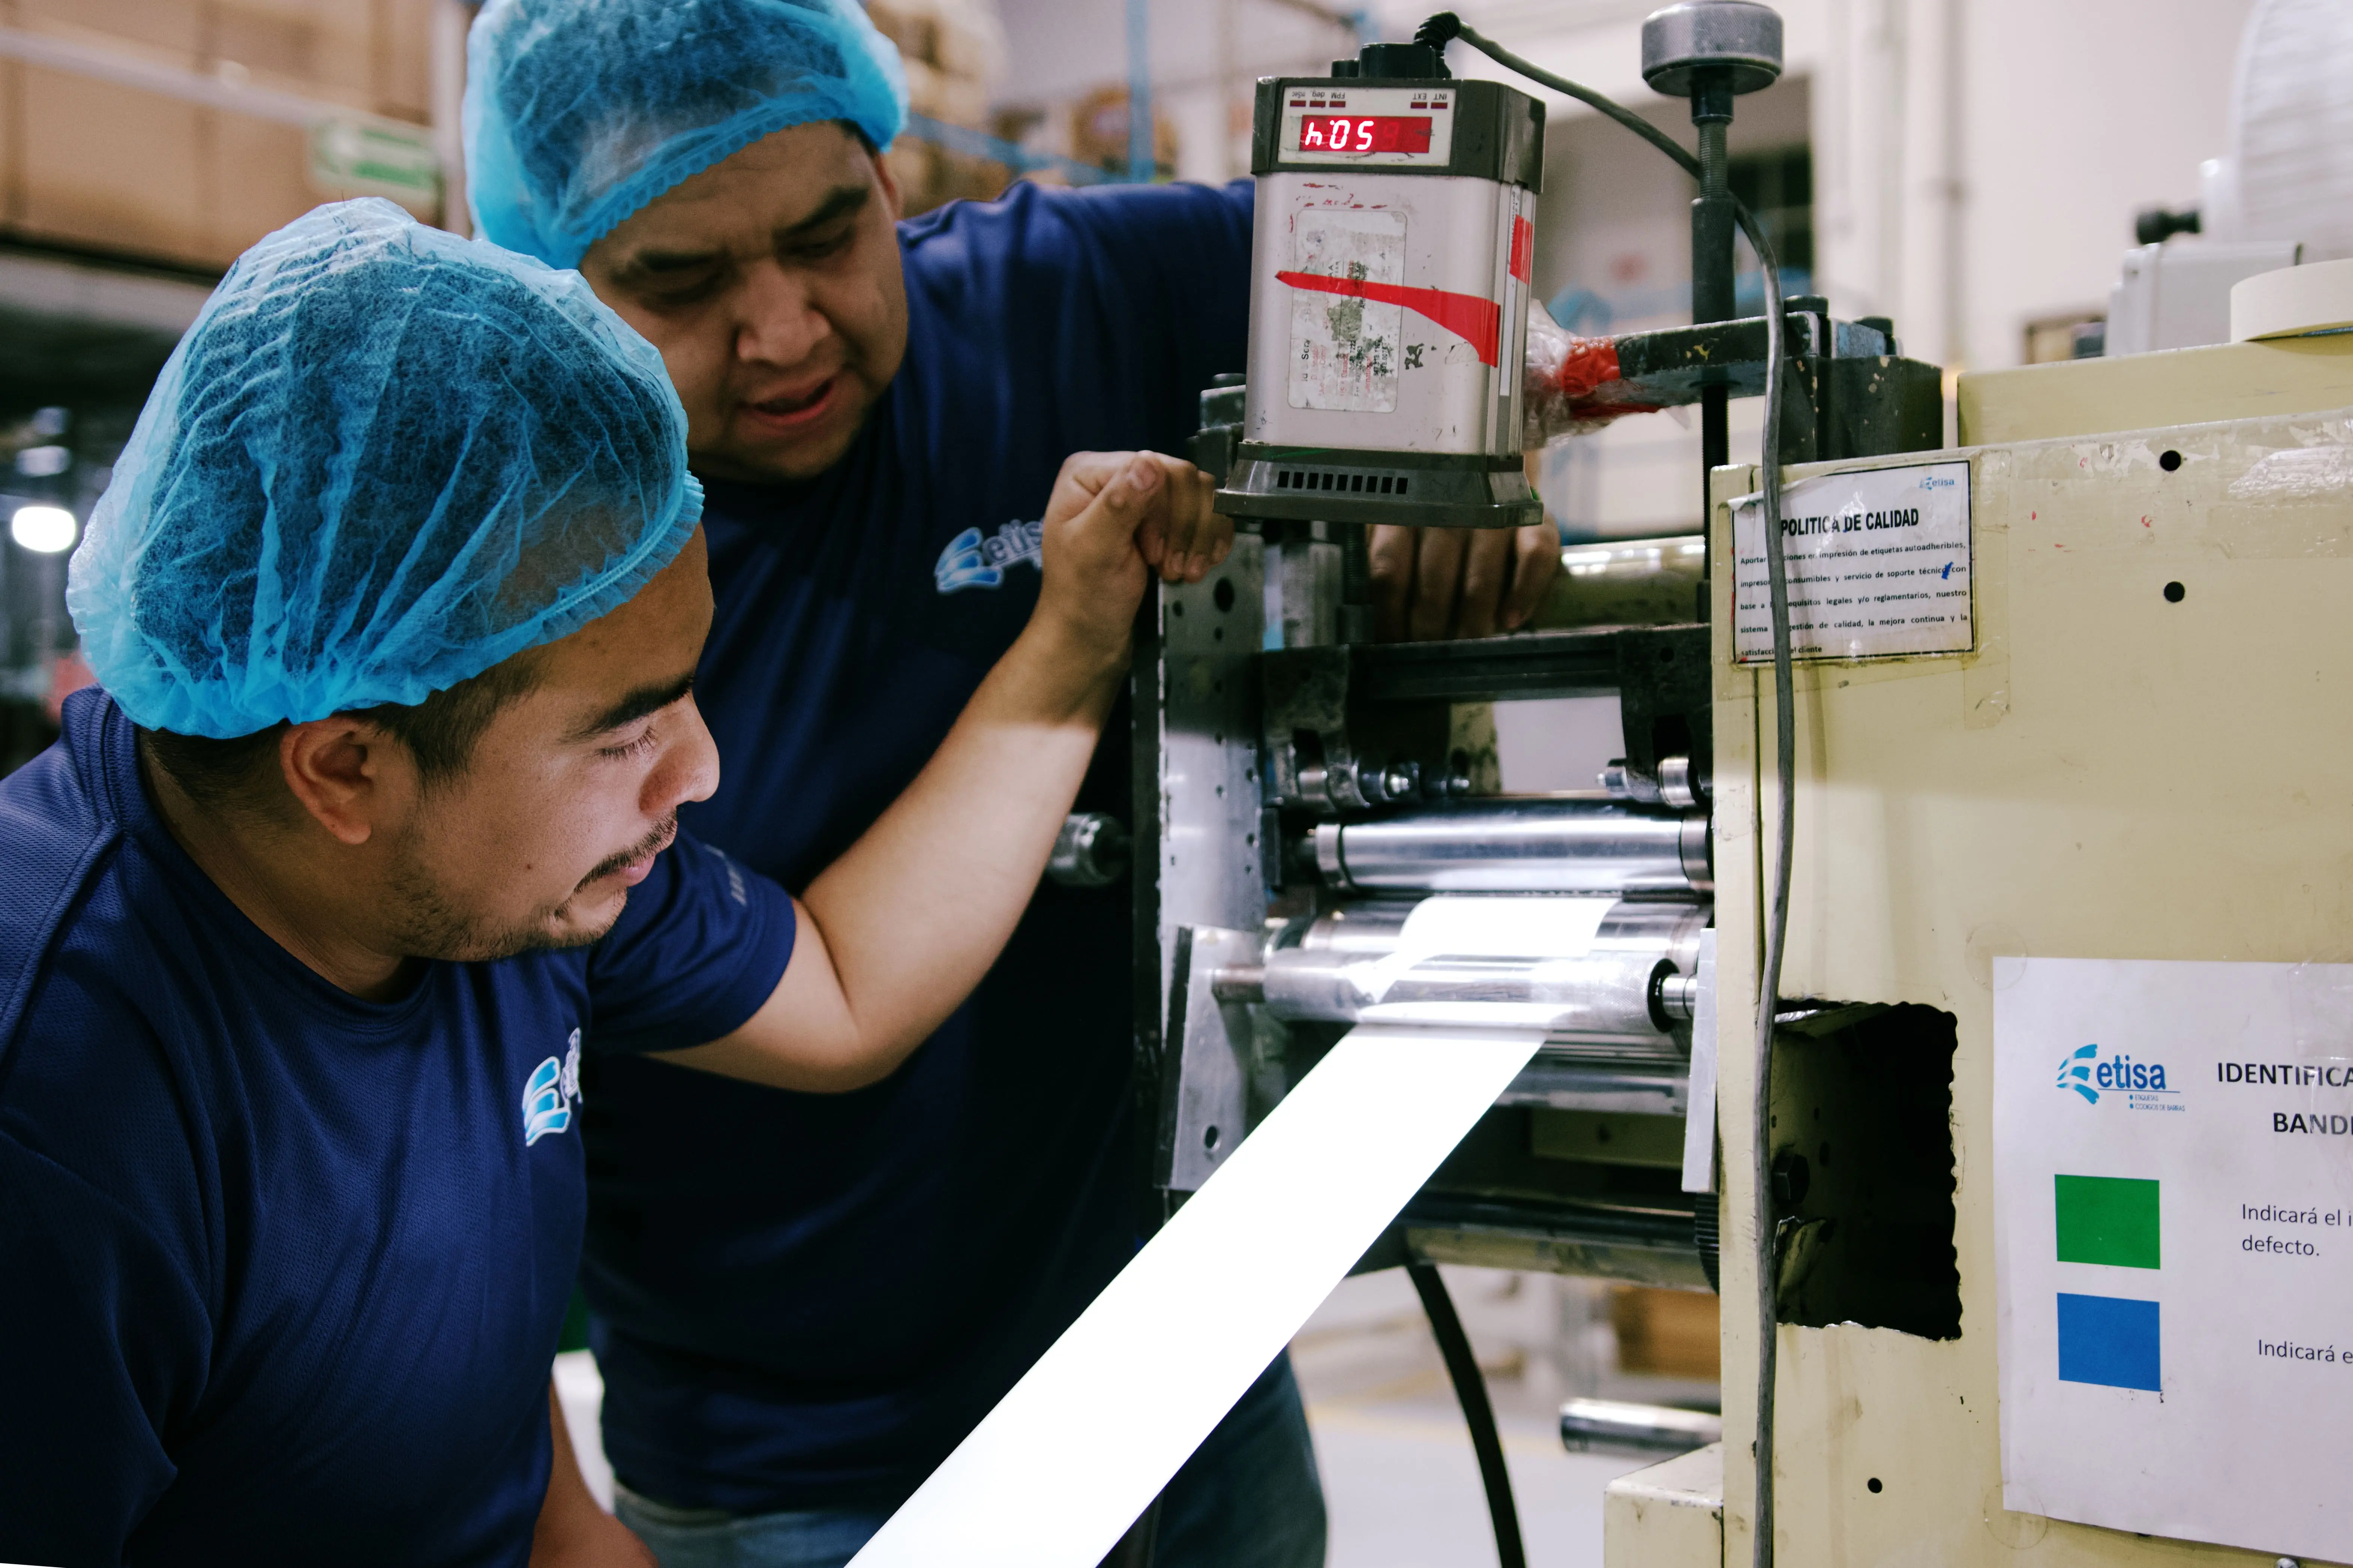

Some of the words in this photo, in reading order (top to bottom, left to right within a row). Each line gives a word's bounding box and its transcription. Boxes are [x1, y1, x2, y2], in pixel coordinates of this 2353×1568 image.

[1932, 478, 1955, 486] etisa
[1781, 514, 1840, 537] POLITICA
[1844, 514, 1862, 532] DE
[1866, 508, 1919, 530] CALIDAD
[1819, 549, 1857, 559] impresión
[1871, 547, 1903, 555] etiquetas
[1905, 541, 1966, 552] autoadheribles,
[1844, 572, 1871, 580] servicio
[1887, 569, 1915, 578] soporte
[1789, 599, 1821, 608] equisitos
[1826, 597, 1852, 606] legales
[1858, 596, 1870, 604] y/o
[1874, 591, 1931, 603] reglamentarios,
[1834, 619, 1864, 628] calidad,
[1880, 618, 1905, 627] mejora
[1911, 615, 1945, 623] continua
[1741, 648, 1774, 656] satisfacci
[2097, 1055, 2166, 1090] etisa
[2242, 1204, 2317, 1224] Indicará
[2324, 1209, 2340, 1226] el
[2242, 1234, 2319, 1256] defecto.
[2258, 1339, 2335, 1362] Indicará
